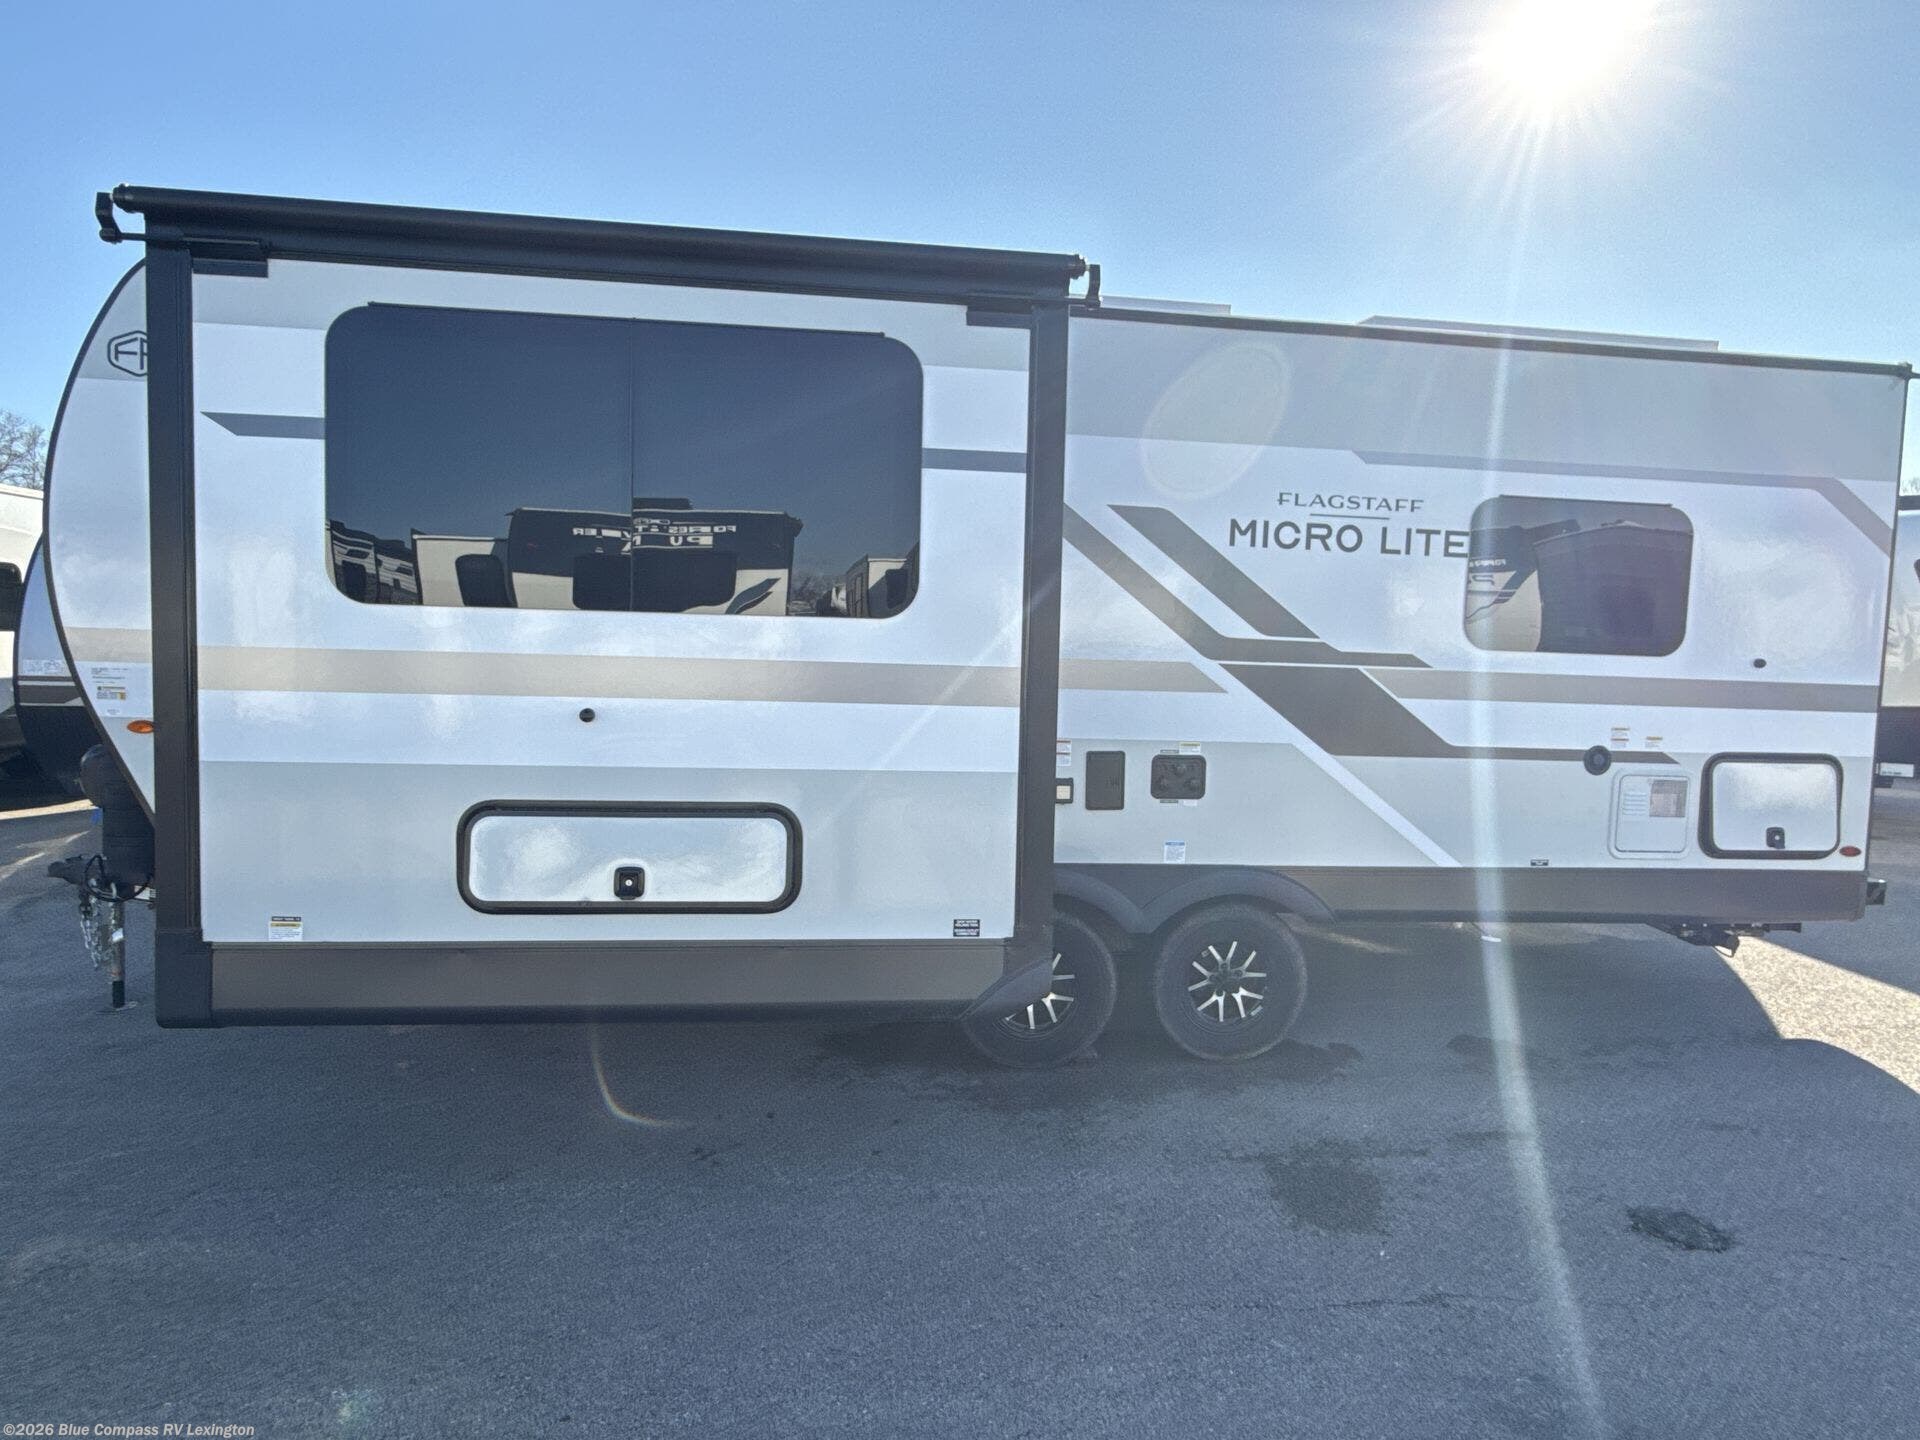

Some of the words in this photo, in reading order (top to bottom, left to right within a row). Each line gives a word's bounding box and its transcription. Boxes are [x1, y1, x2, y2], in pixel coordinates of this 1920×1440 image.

[1277, 492, 1424, 513] FLAGSTAFF
[1229, 517, 1363, 553] MICRO
[1380, 526, 1470, 558] LITE
